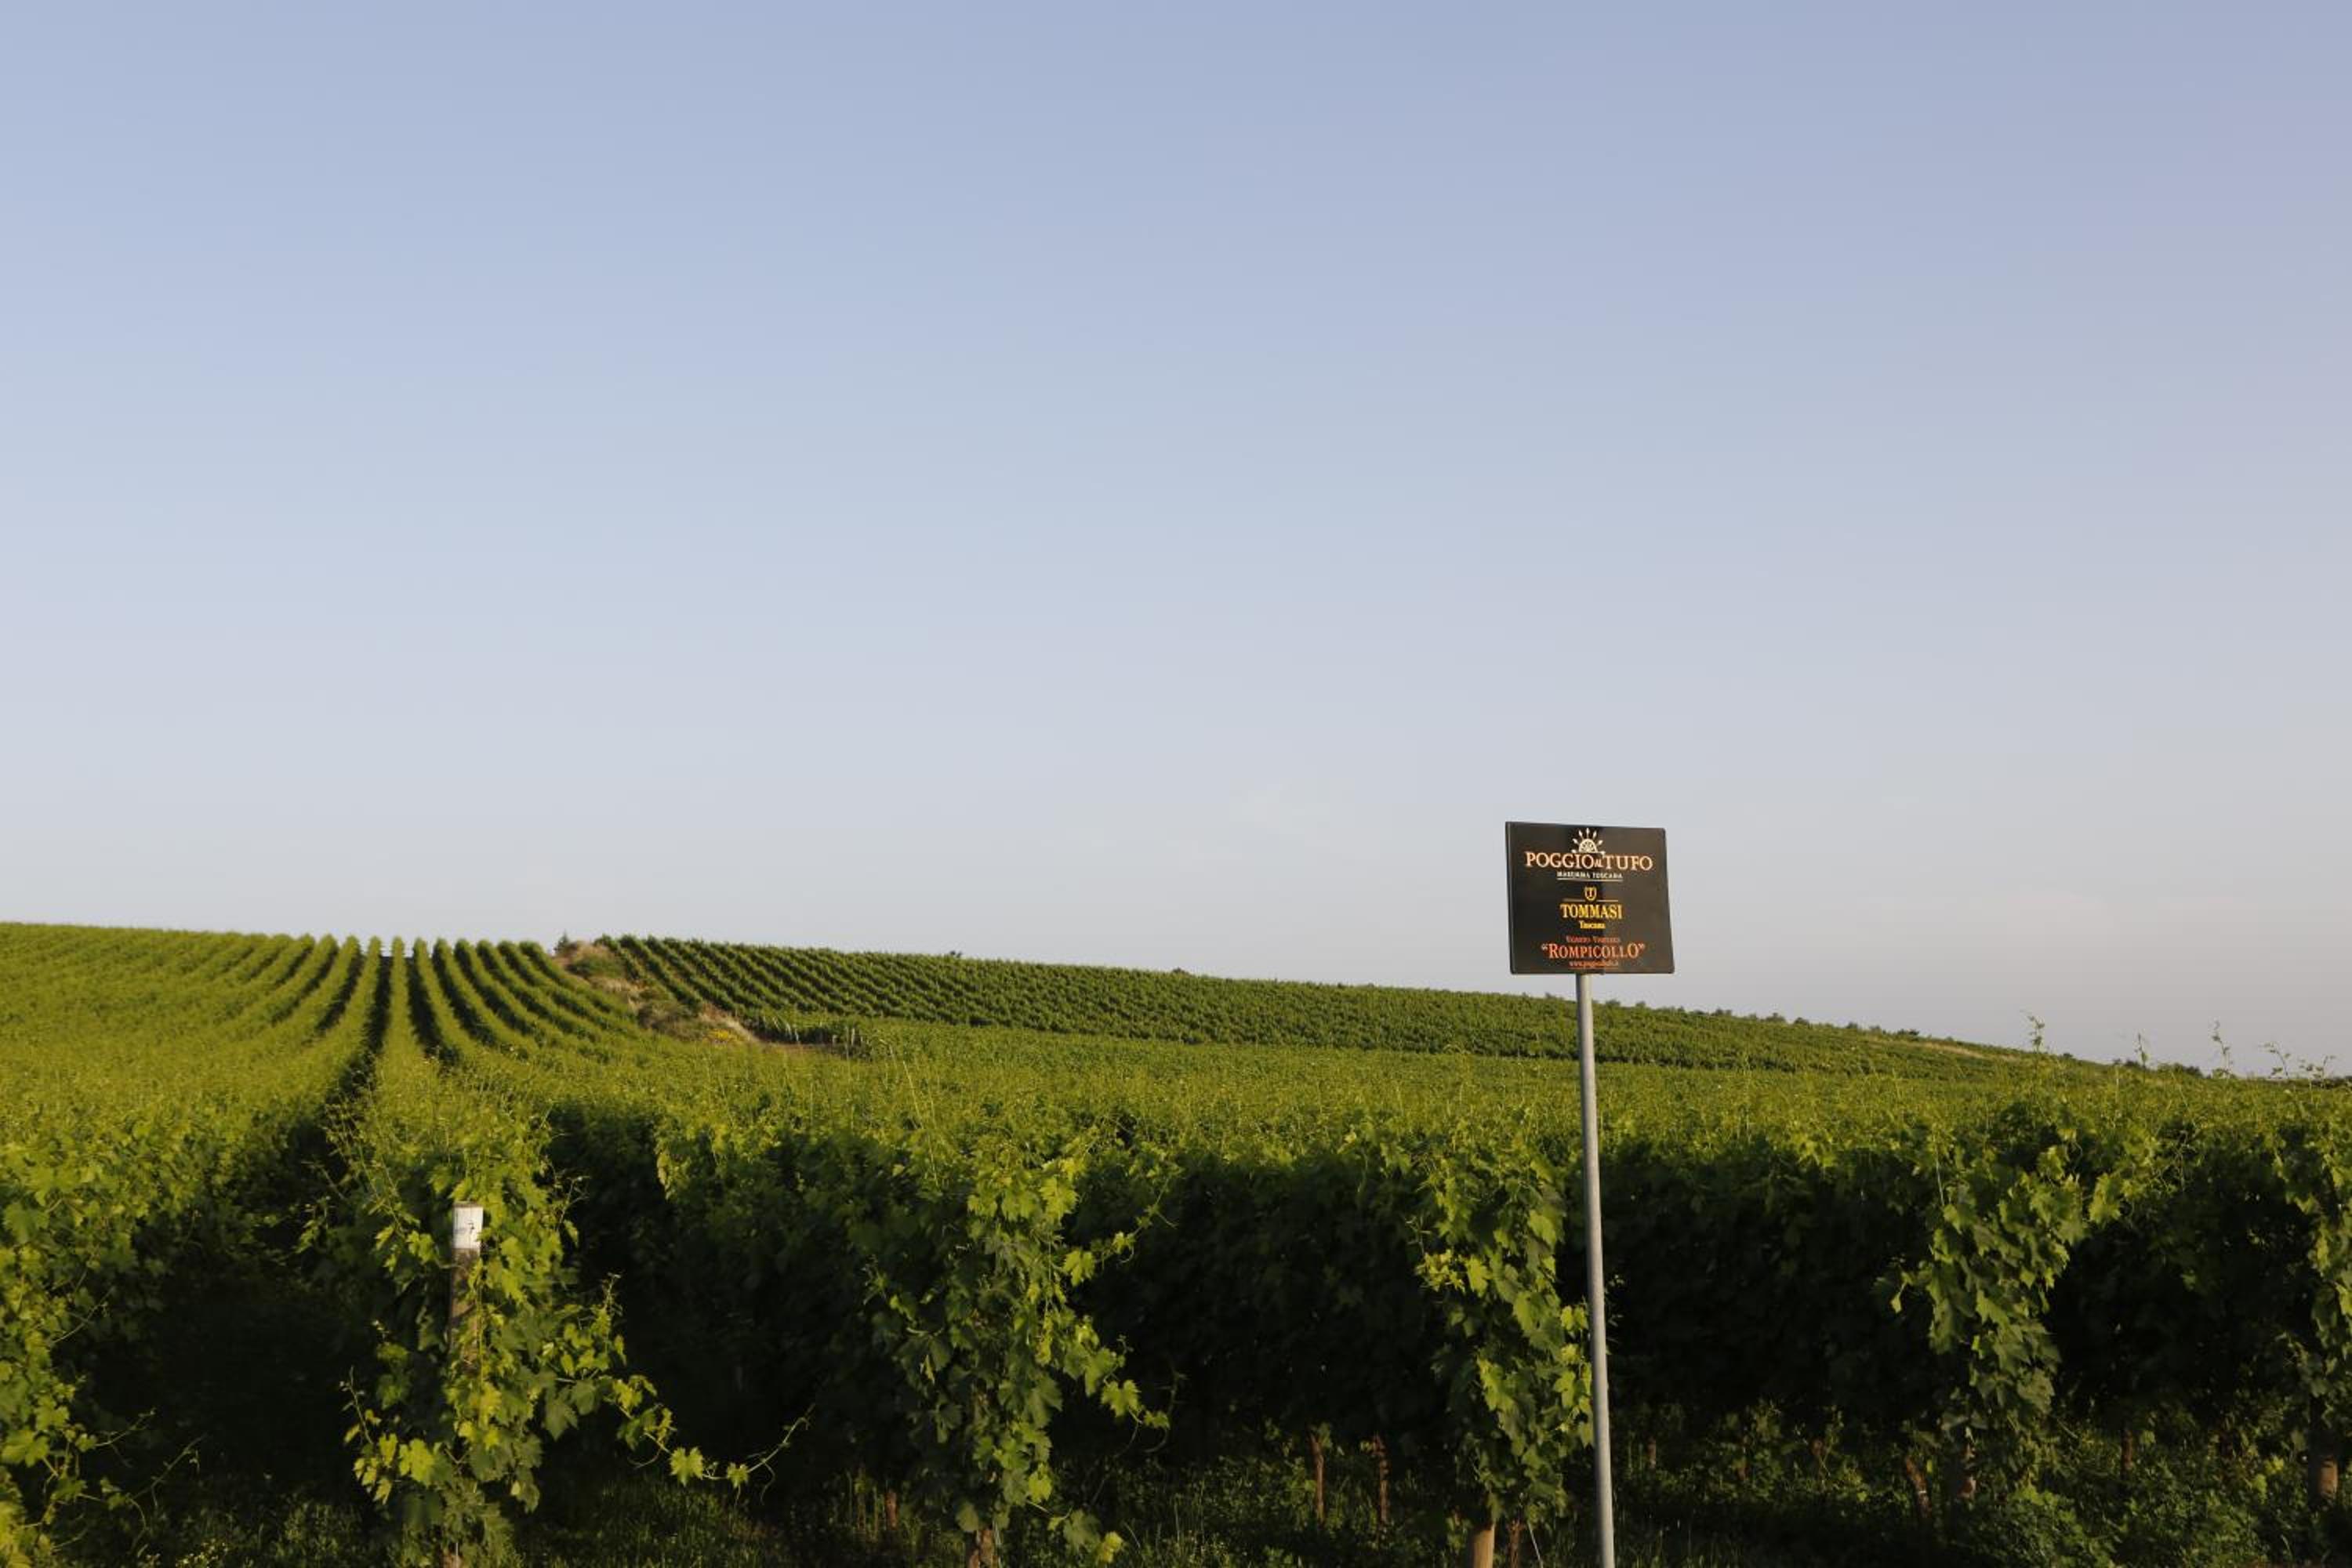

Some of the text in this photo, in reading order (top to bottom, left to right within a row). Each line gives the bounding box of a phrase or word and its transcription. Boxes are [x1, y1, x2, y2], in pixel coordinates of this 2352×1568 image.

[1525, 851, 1594, 868] POGGIO
[1602, 855, 1653, 871] TUFO
[1560, 904, 1623, 920] TOMMASI
